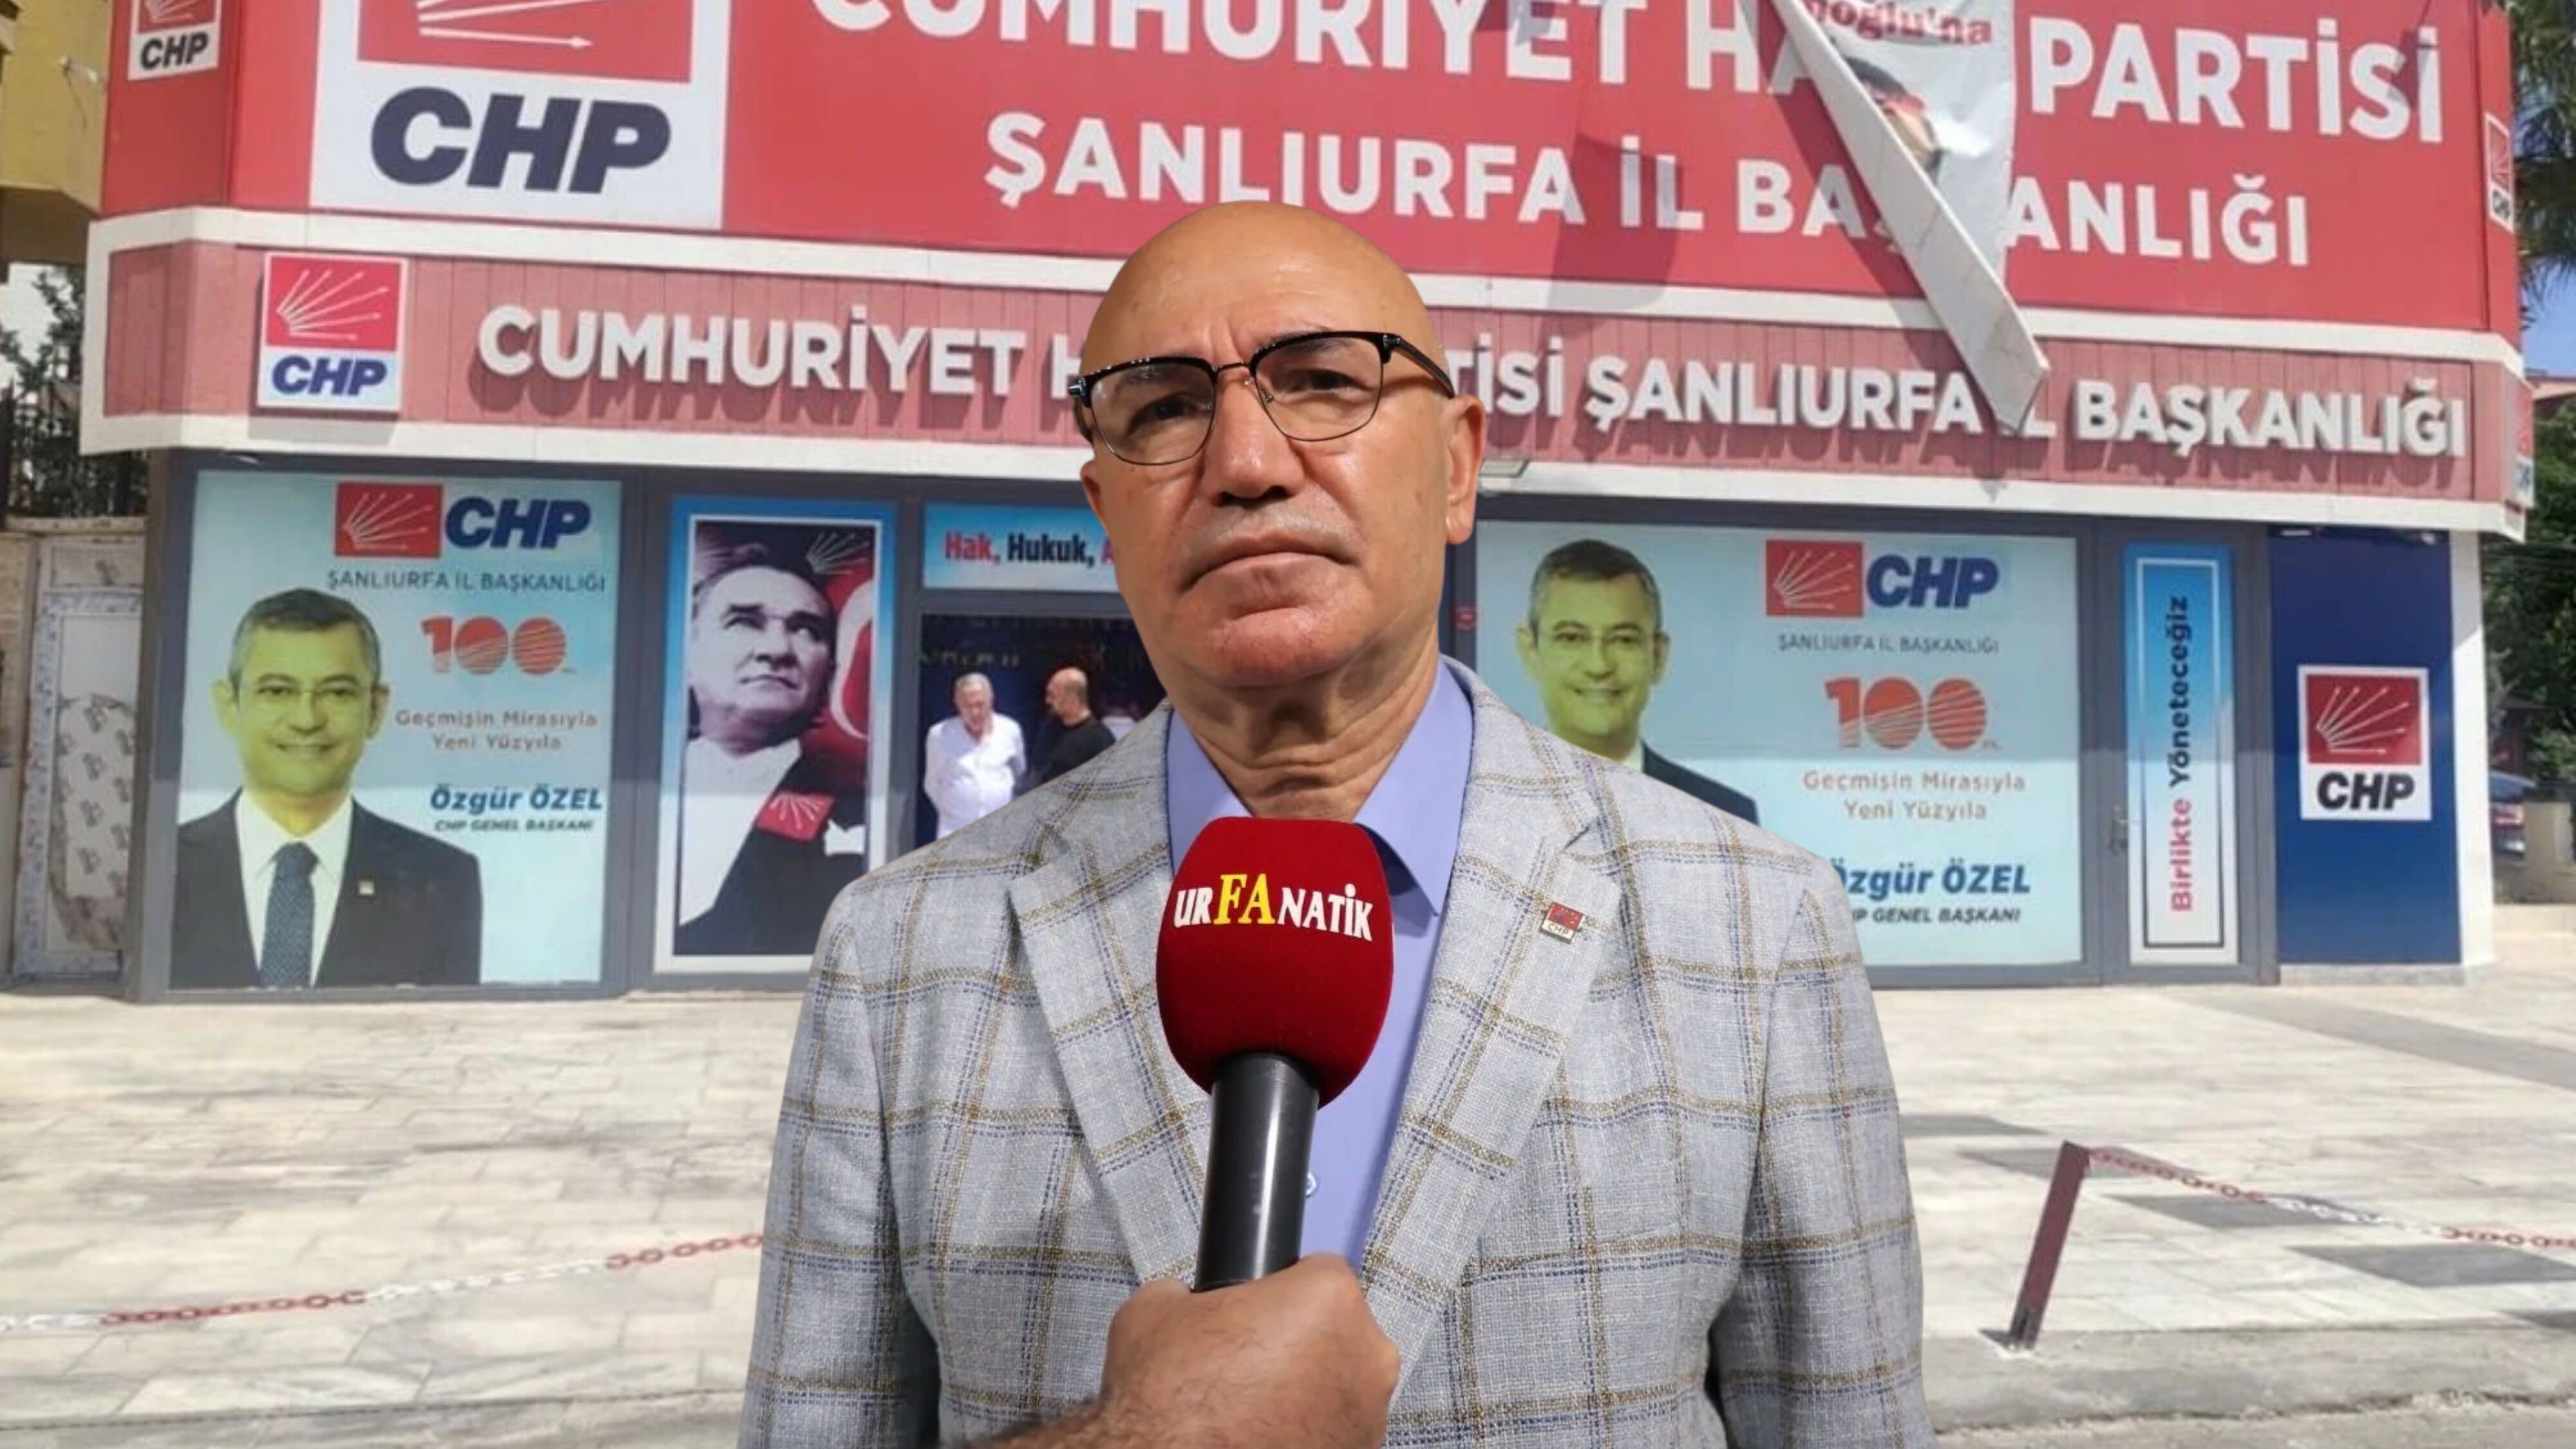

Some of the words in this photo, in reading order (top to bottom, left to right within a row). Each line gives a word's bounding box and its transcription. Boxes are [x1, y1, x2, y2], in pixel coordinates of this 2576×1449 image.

[140, 32, 209, 70] CHP
[2029, 17, 2443, 143] PARTİSİ
[371, 86, 671, 194] CHP
[983, 111, 1586, 223] ŞANLIURFA
[1620, 135, 1703, 232] İL
[1737, 159, 2308, 265] BAANLIĞI
[271, 355, 386, 397] CHP
[478, 302, 1025, 399] CUMHURİYET
[1584, 355, 1984, 435] ŞANLIURFA
[2075, 378, 2465, 457] BAŞKANLIĞI
[445, 497, 591, 549] CHP
[944, 531, 1000, 565] Hak,
[1007, 531, 1094, 567] Hukuk,
[327, 570, 449, 591] ŞANLIURFA
[455, 571, 474, 589] İL
[480, 572, 605, 592] BAŞKANLIĞI
[1866, 555, 1999, 609] CHP
[421, 616, 565, 674] 100
[1778, 634, 1875, 651] ŞANLIURFA
[1900, 635, 1999, 654] BAŞKANLIĞI
[2166, 596, 2192, 788] Yöneteceğiz
[396, 710, 493, 728] Geçmişin
[1824, 676, 1986, 749] 100
[432, 734, 475, 749] Yeni
[430, 784, 522, 815] Özgür
[530, 783, 603, 810] ÖZEL
[1922, 773, 2025, 793] Mirasıyla
[2318, 773, 2415, 810] CHP
[1844, 800, 1893, 819] Yeni
[1903, 800, 1987, 821] Yüzyıla
[2170, 799, 2192, 911] Birlikte
[1941, 857, 2031, 894] ÖZEL
[1873, 908, 1931, 923] GENEL
[1938, 908, 2021, 924] BAŞKANI
